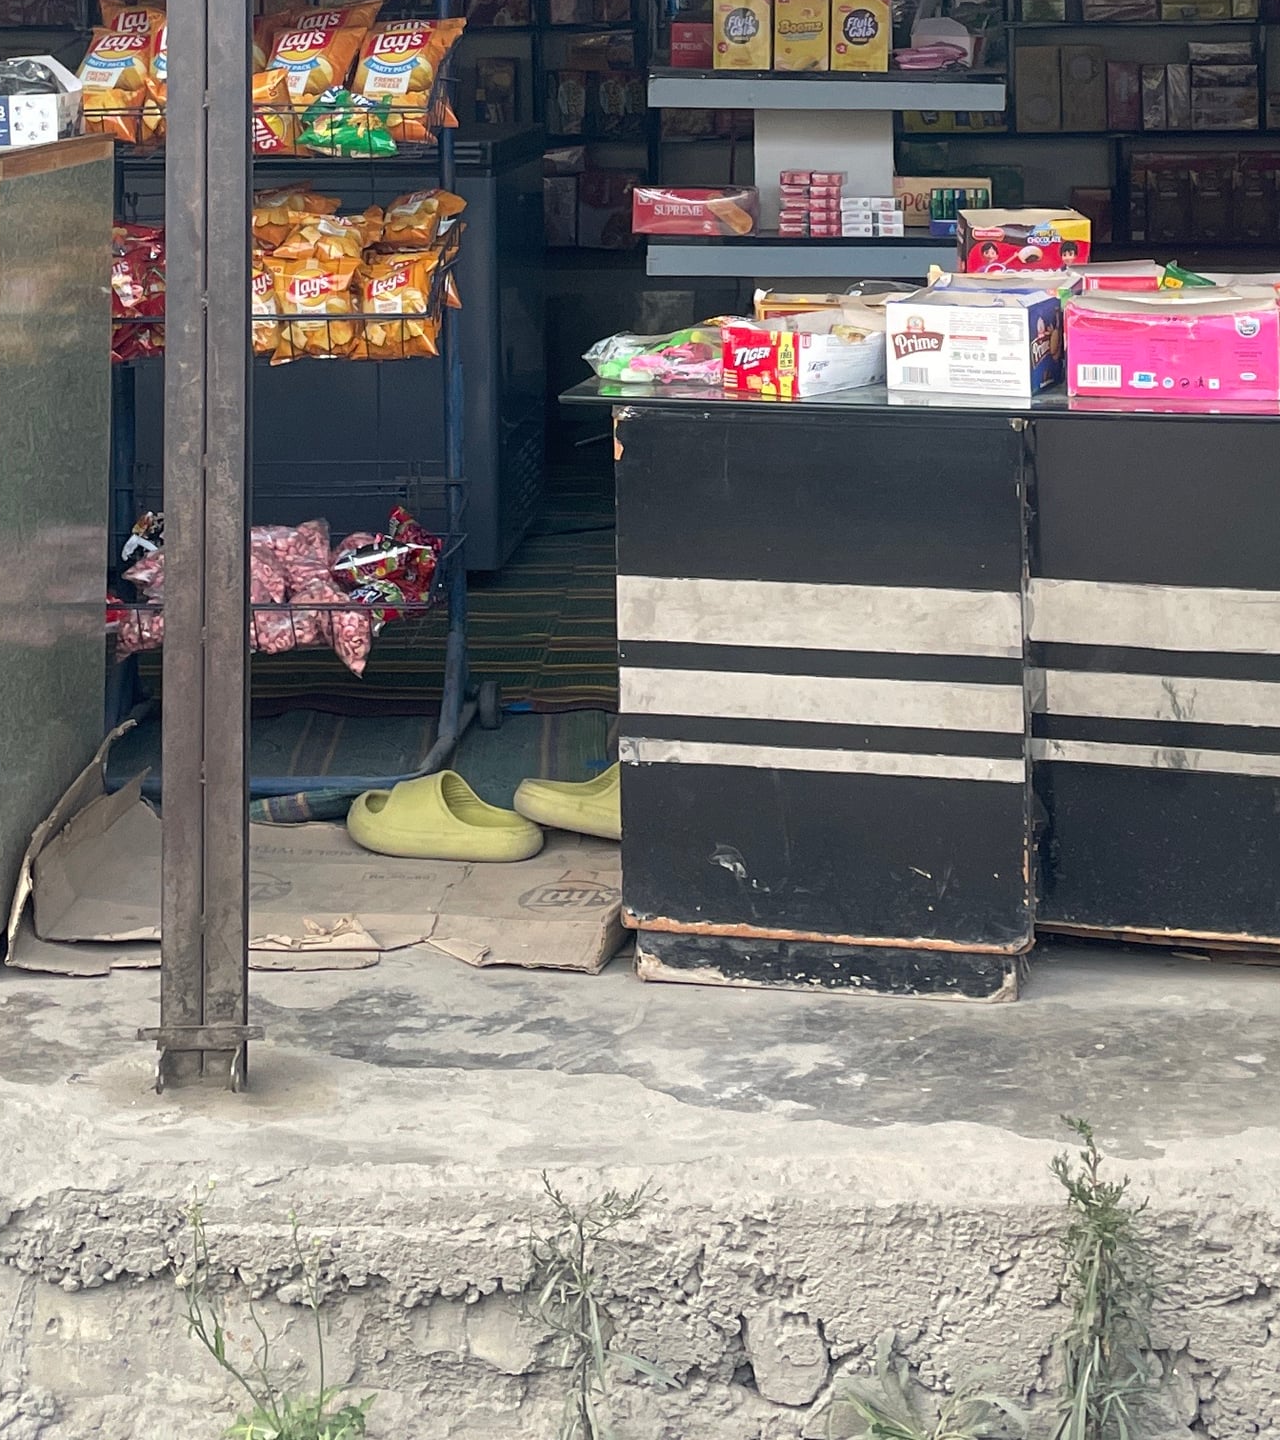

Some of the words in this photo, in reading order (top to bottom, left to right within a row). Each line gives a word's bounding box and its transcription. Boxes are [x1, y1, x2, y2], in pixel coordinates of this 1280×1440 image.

[845, 12, 874, 30] Fruit
[277, 30, 326, 52] Lay's
[848, 26, 876, 37] Gala
[94, 34, 146, 51] Lay's
[373, 32, 424, 54] Lay's
[370, 63, 393, 73] PARTY
[394, 63, 412, 73] PACK
[654, 204, 703, 216] SUPREME
[294, 276, 332, 297] Lay's
[895, 334, 940, 355] Prime
[734, 346, 771, 366] TIGER
